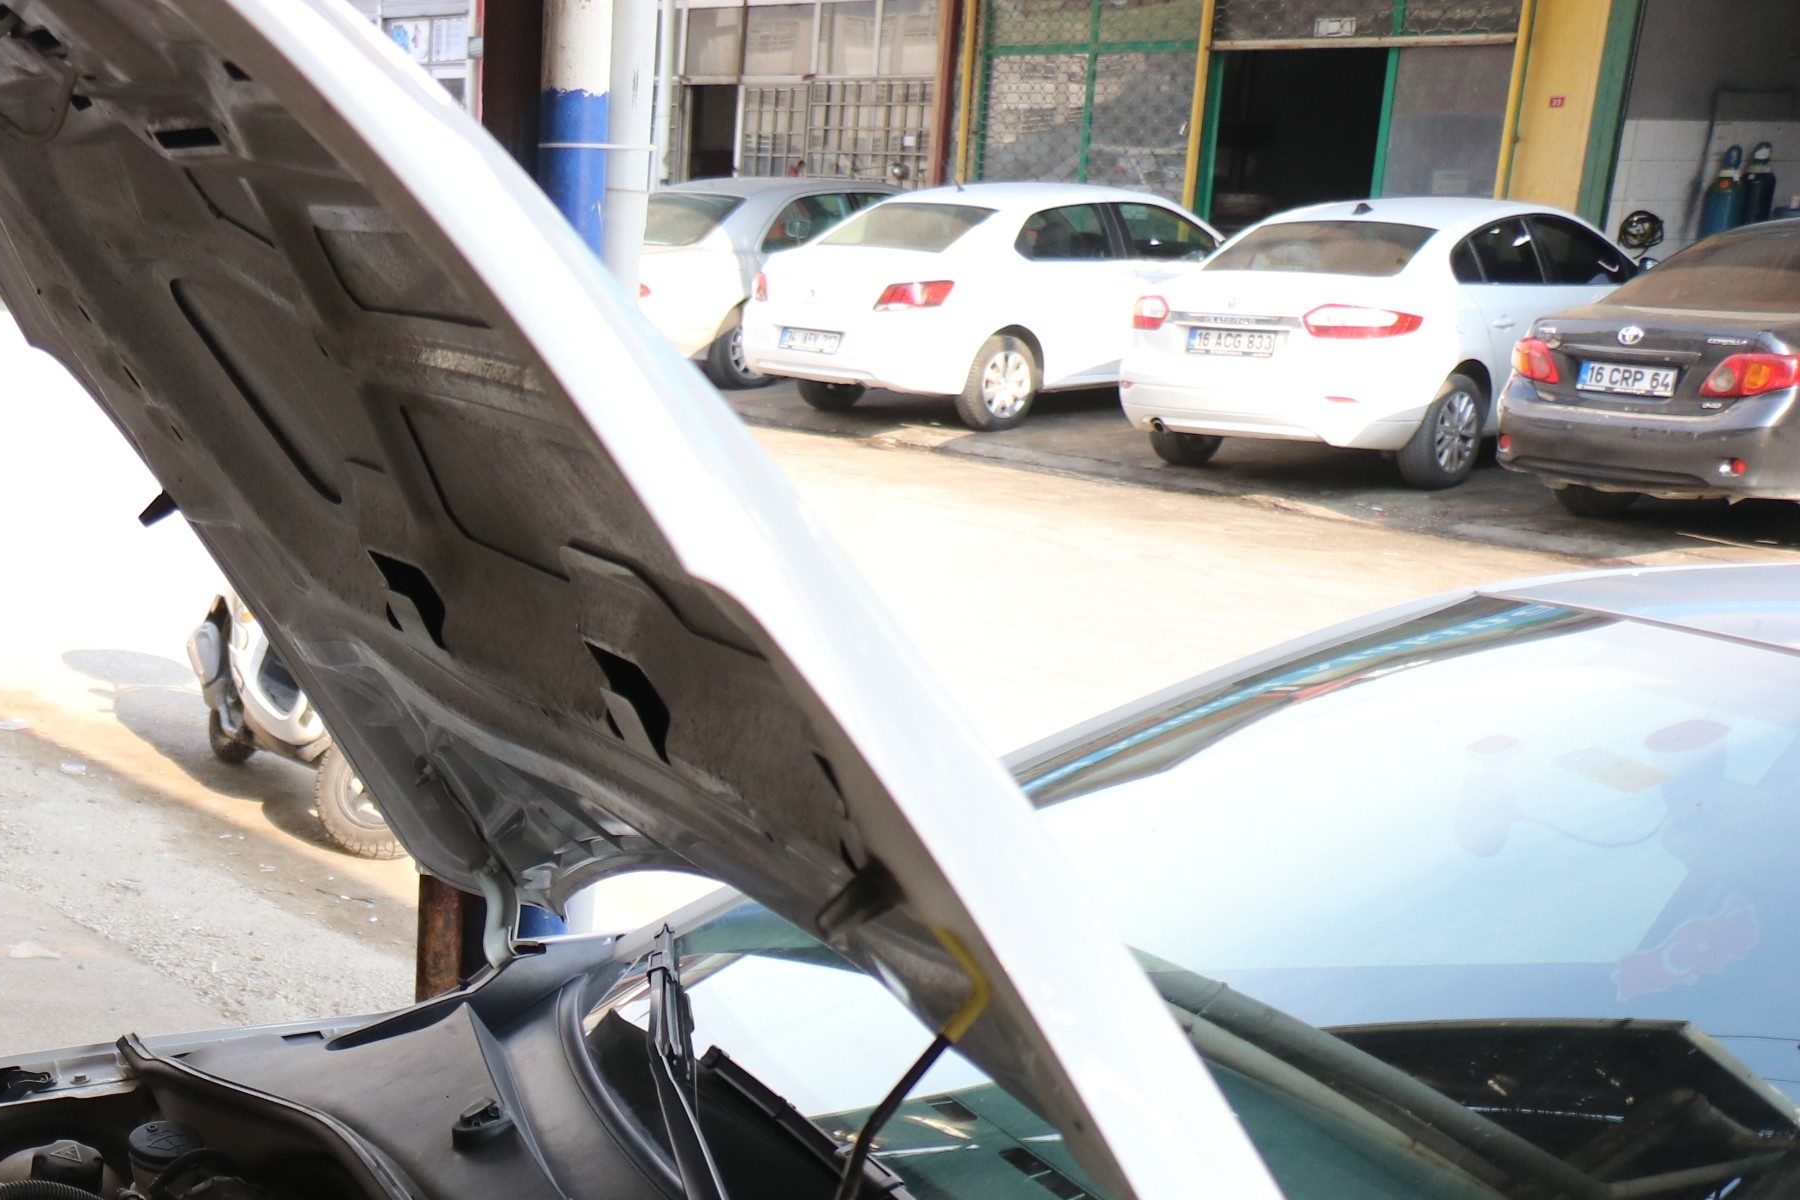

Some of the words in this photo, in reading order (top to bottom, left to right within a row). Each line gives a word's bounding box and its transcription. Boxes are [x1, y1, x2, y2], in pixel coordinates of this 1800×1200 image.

[1198, 332, 1211, 347] 16
[1215, 333, 1242, 349] ACG
[1246, 334, 1273, 350] 833
[1589, 366, 1605, 383] 16
[1609, 368, 1644, 387] CRP
[1649, 372, 1670, 390] 64
